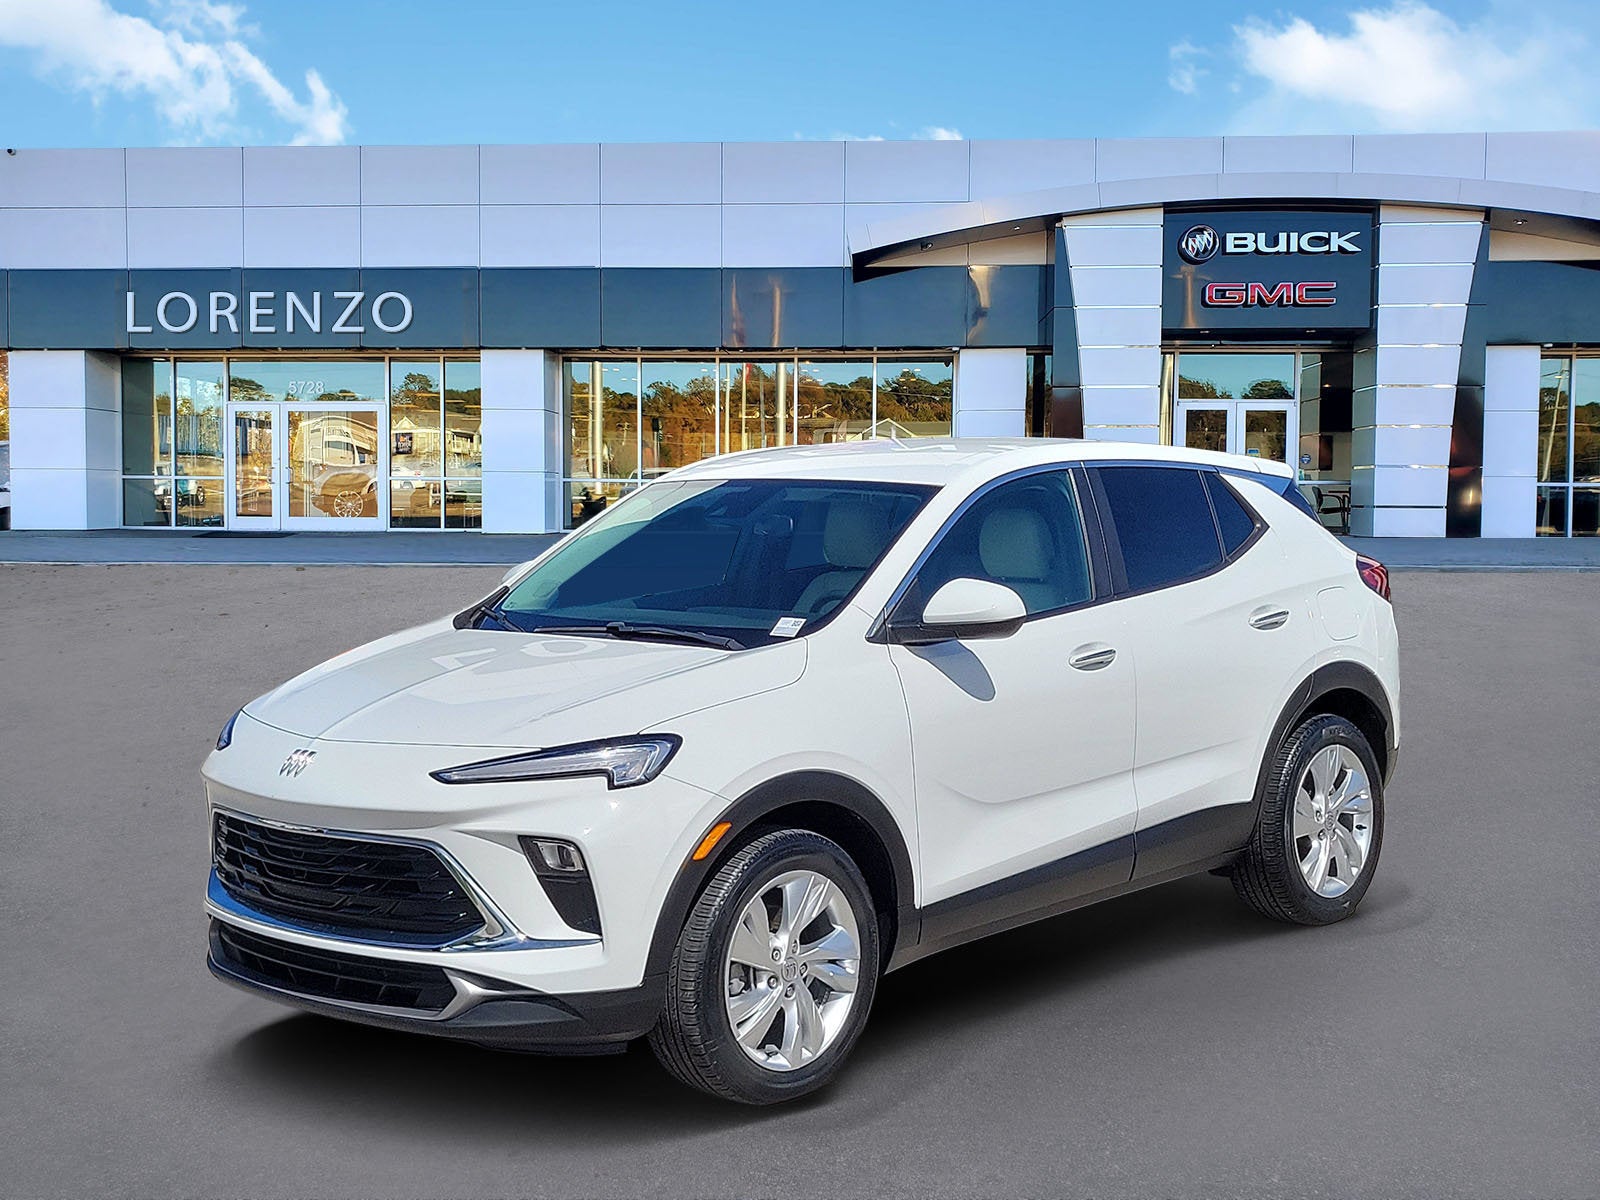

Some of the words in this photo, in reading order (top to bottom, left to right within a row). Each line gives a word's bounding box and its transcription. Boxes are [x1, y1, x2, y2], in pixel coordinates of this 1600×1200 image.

[1225, 231, 1362, 253] BUICK
[1204, 281, 1337, 306] GMC
[126, 290, 414, 334] LORENZO
[288, 380, 325, 394] 5728
